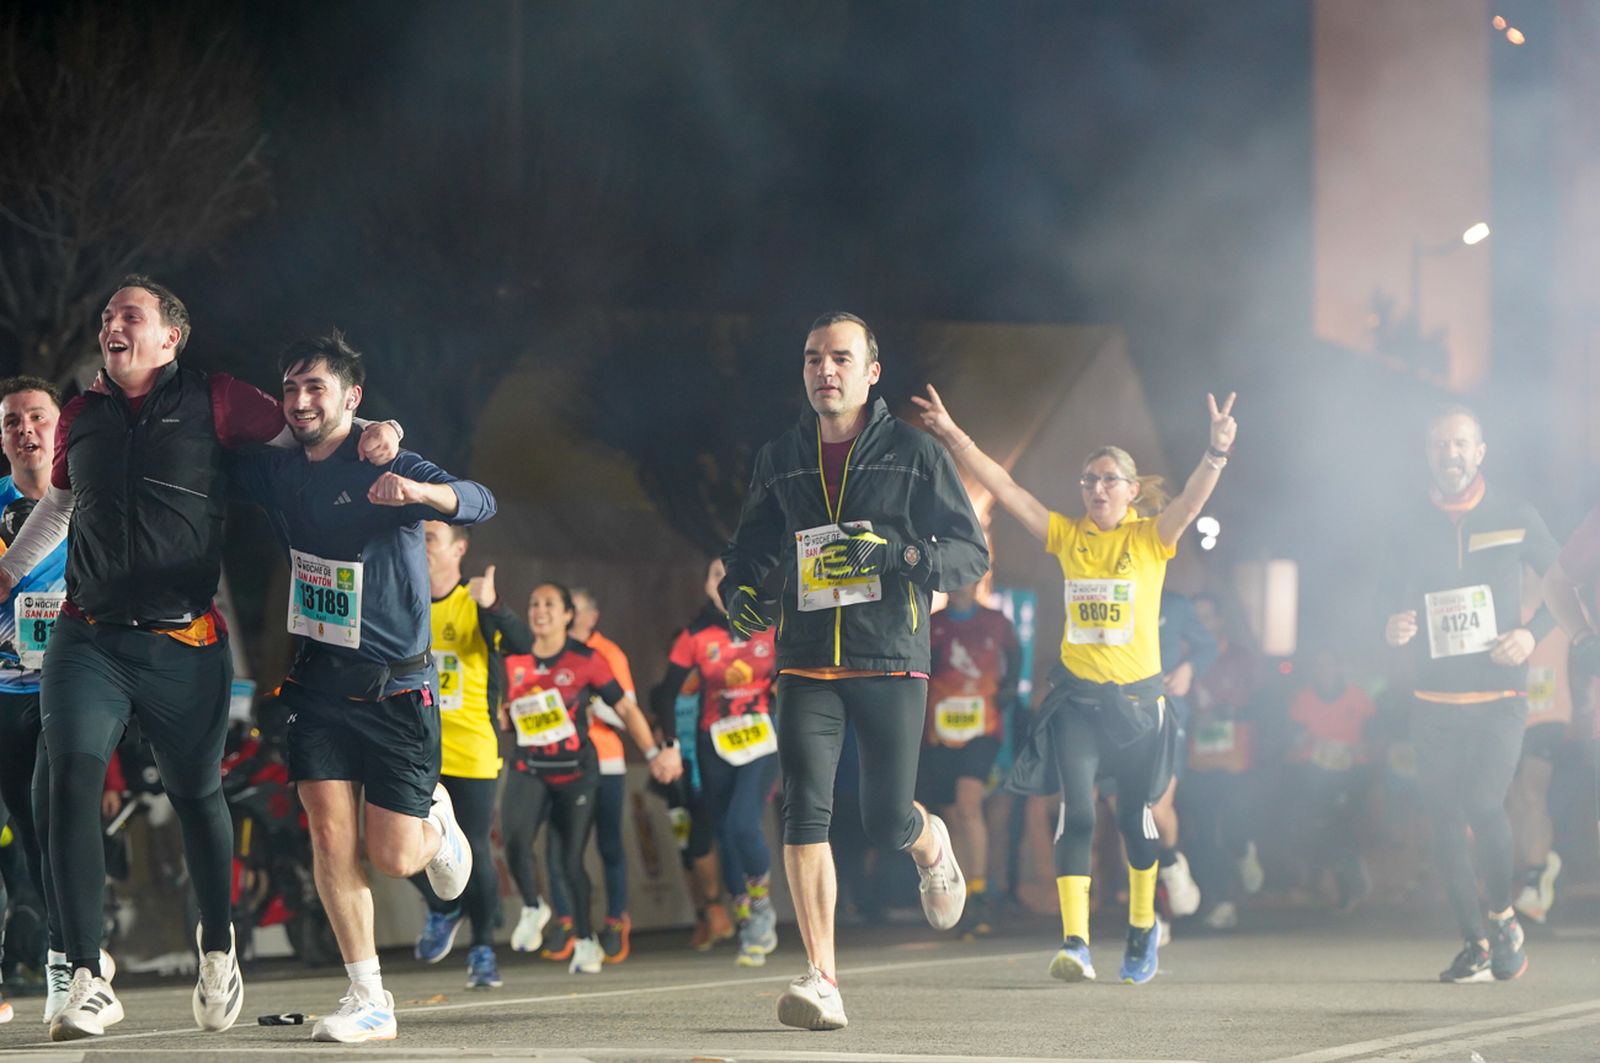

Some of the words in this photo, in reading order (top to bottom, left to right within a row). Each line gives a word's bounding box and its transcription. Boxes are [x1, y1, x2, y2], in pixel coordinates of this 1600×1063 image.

[805, 547, 818, 558] SAN
[303, 563, 323, 575] NOCHE
[323, 567, 332, 576] DE
[298, 571, 308, 582] SAN
[301, 582, 349, 617] 13189
[25, 610, 42, 618] SAN
[1079, 602, 1120, 622] 8805
[1440, 611, 1480, 633] 4124
